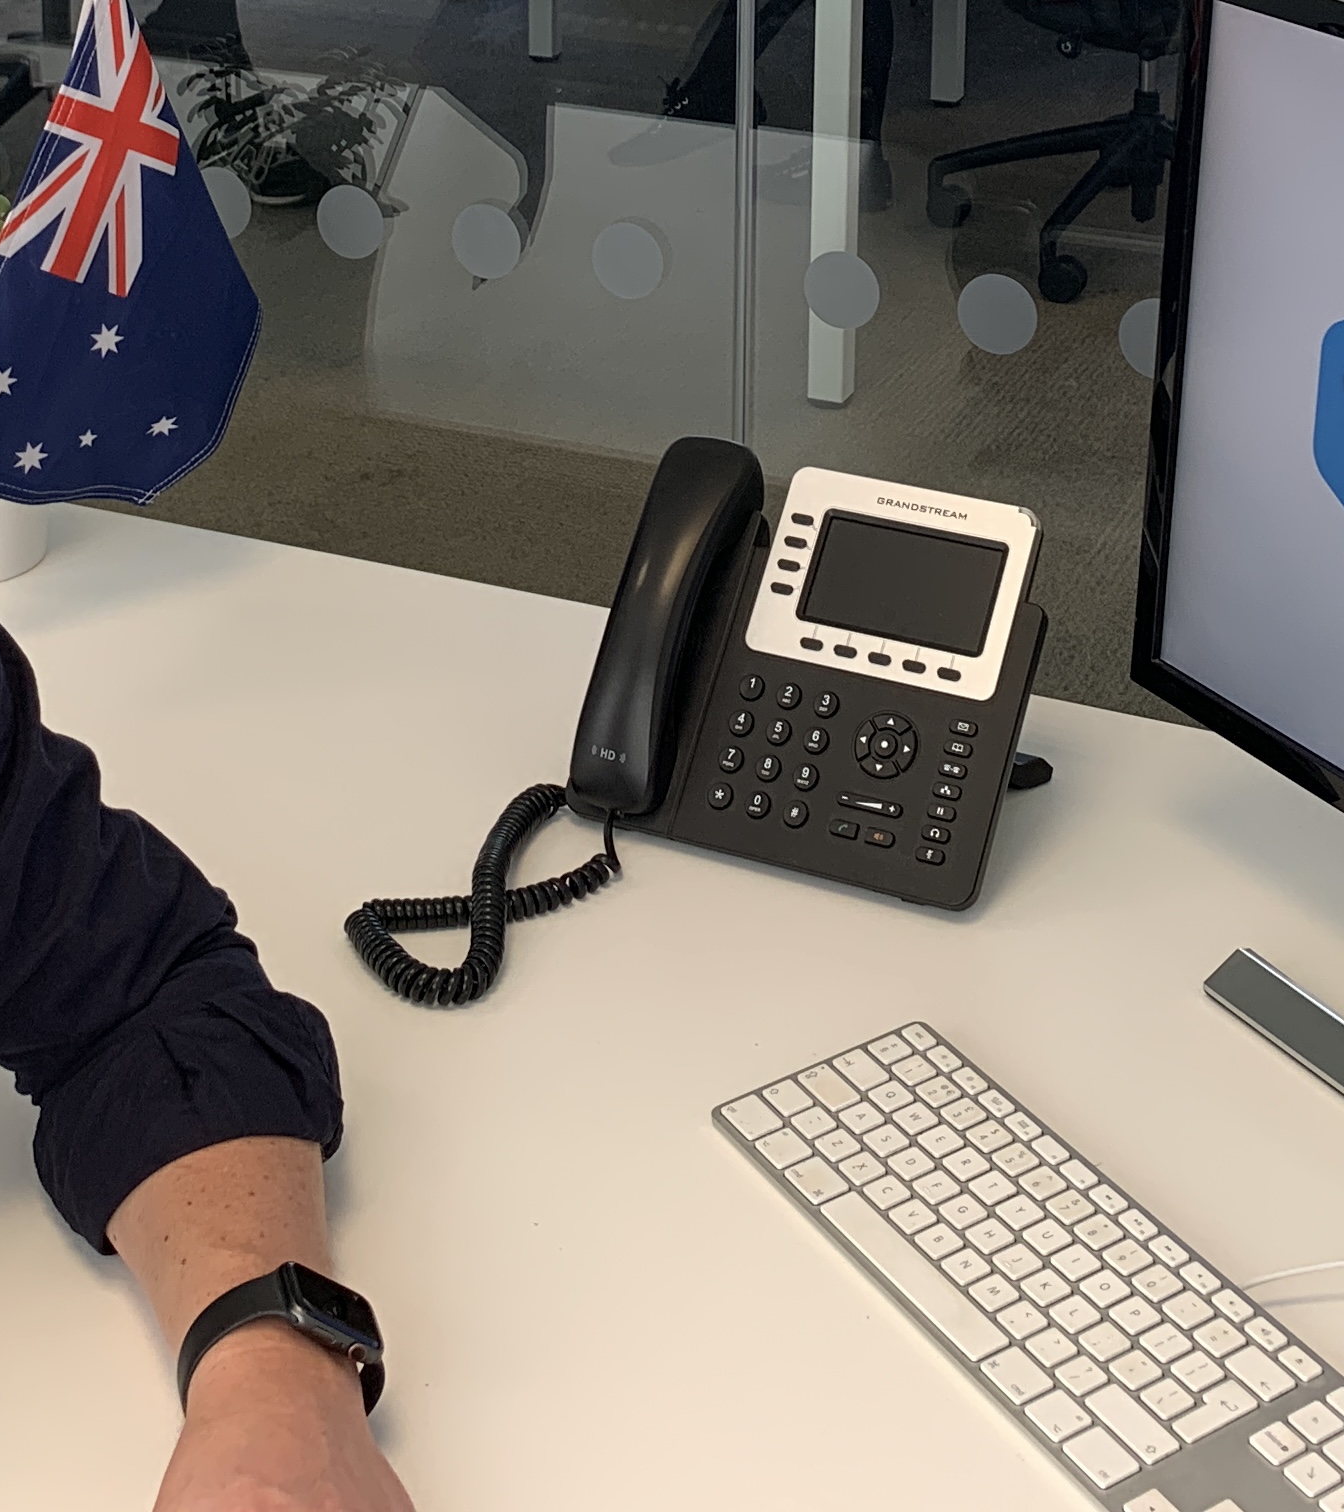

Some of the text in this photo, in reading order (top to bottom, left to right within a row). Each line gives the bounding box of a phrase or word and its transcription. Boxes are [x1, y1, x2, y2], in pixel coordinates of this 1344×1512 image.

[876, 496, 968, 521] GRANDSTREAM
[749, 677, 831, 706] 1 2 3
[737, 712, 821, 742] 4 5 6
[599, 747, 616, 761] HD
[727, 748, 810, 779] 7 8 9
